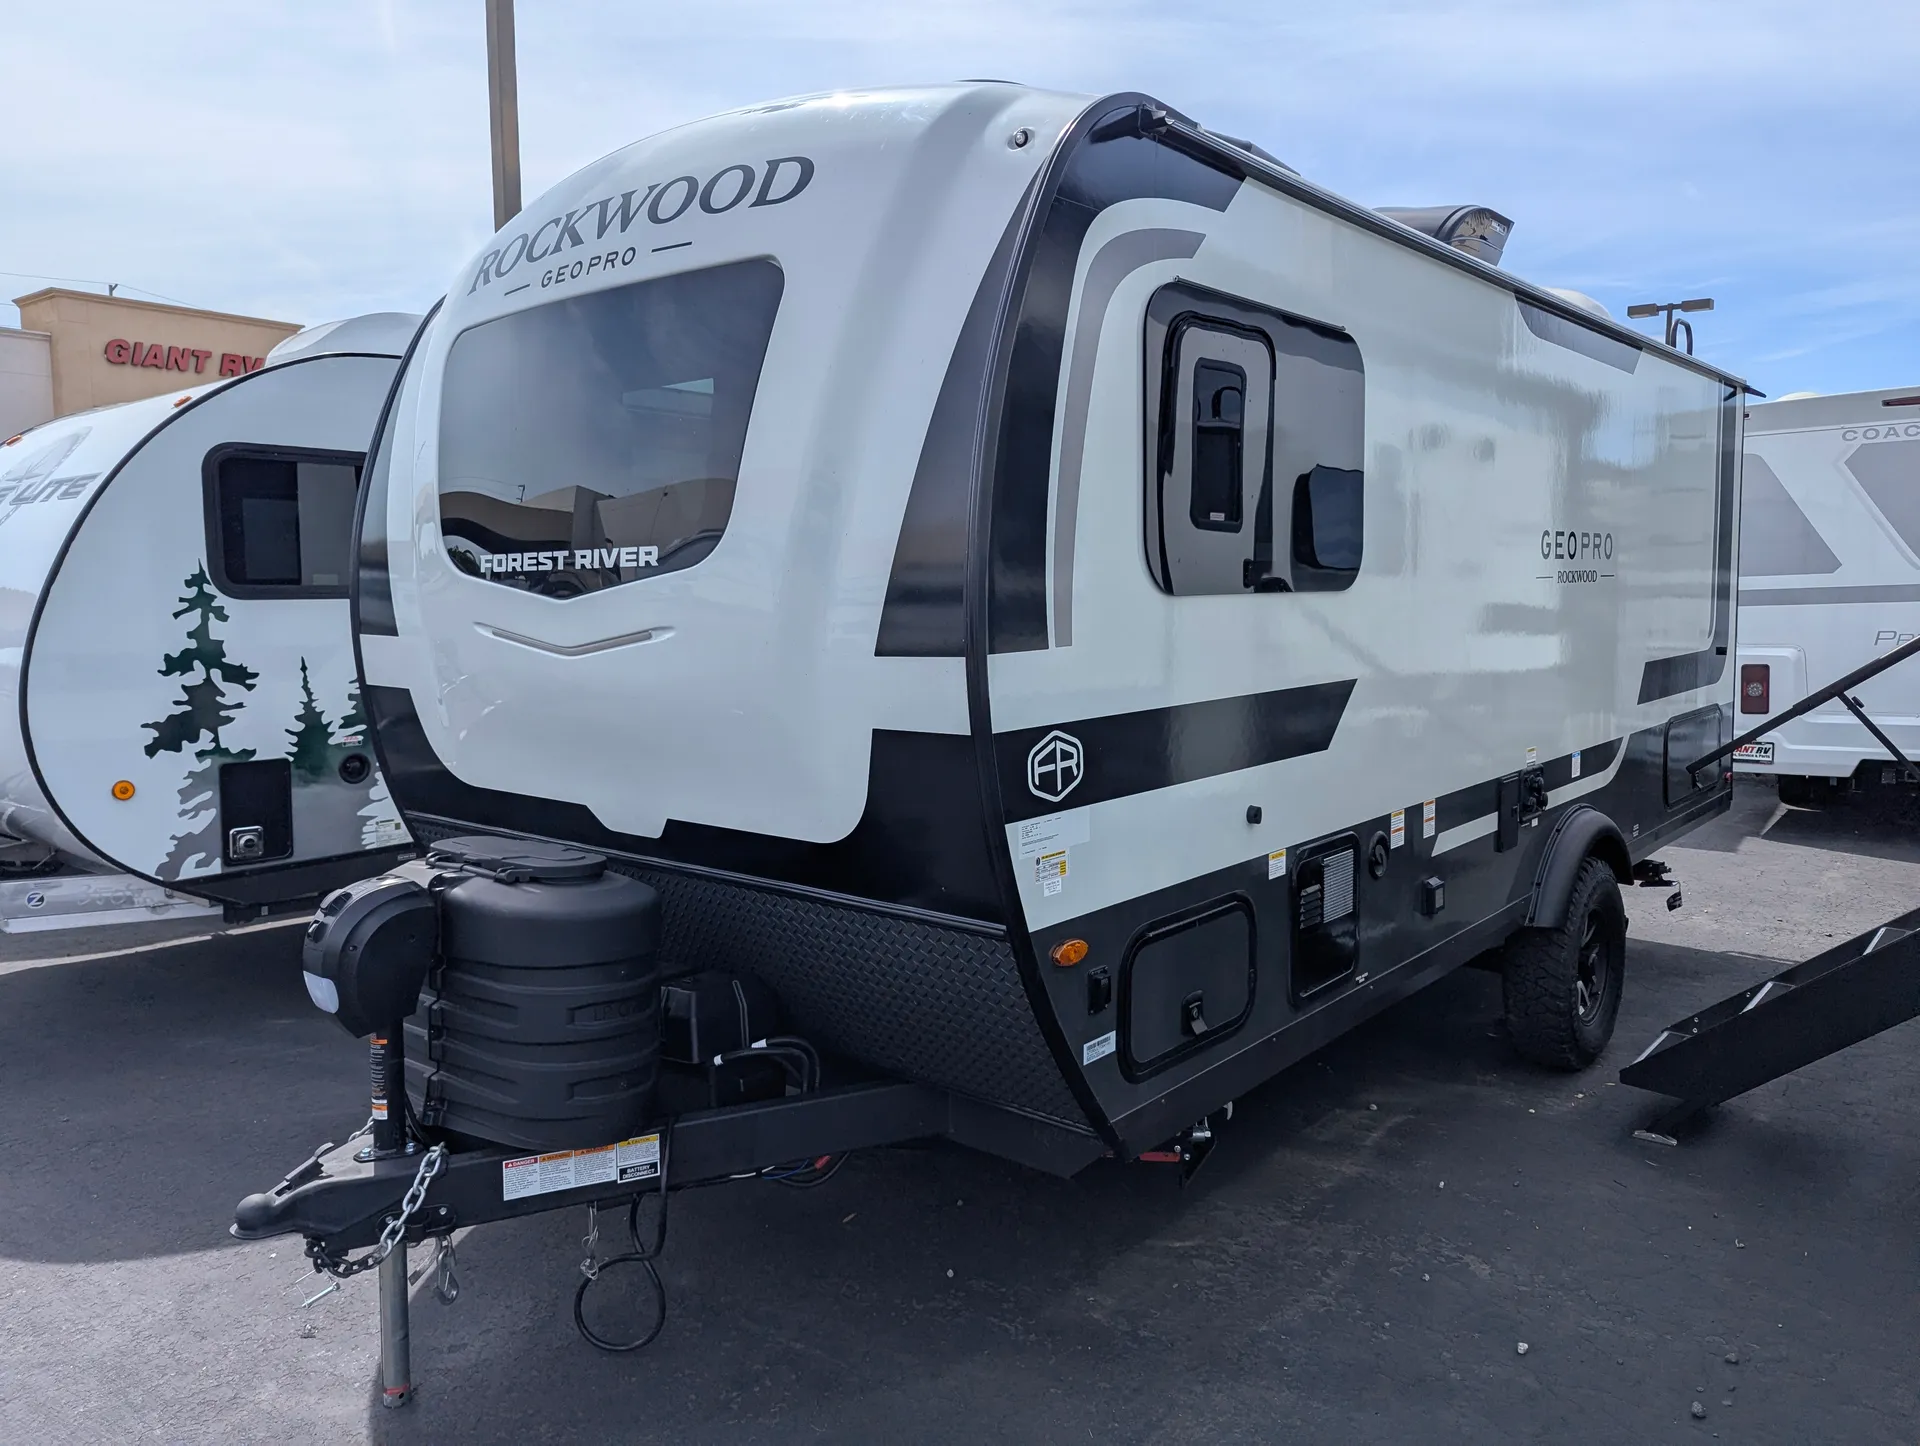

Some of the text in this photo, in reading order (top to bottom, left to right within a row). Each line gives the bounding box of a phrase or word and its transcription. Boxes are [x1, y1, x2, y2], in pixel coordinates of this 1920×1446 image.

[466, 156, 815, 297] ROCKWOOD
[540, 246, 637, 289] GEOPRO
[105, 338, 265, 377] GIANT RV
[1841, 424, 1920, 442] COAC
[1541, 529, 1613, 560] GEOPRO
[479, 545, 659, 573] FOREST RIVER
[1557, 570, 1598, 583] ROCKWOOD
[512, 1158, 535, 1167] DANGER
[622, 1168, 656, 1180] DISCONNECT
[626, 1164, 651, 1174] BATTERY
